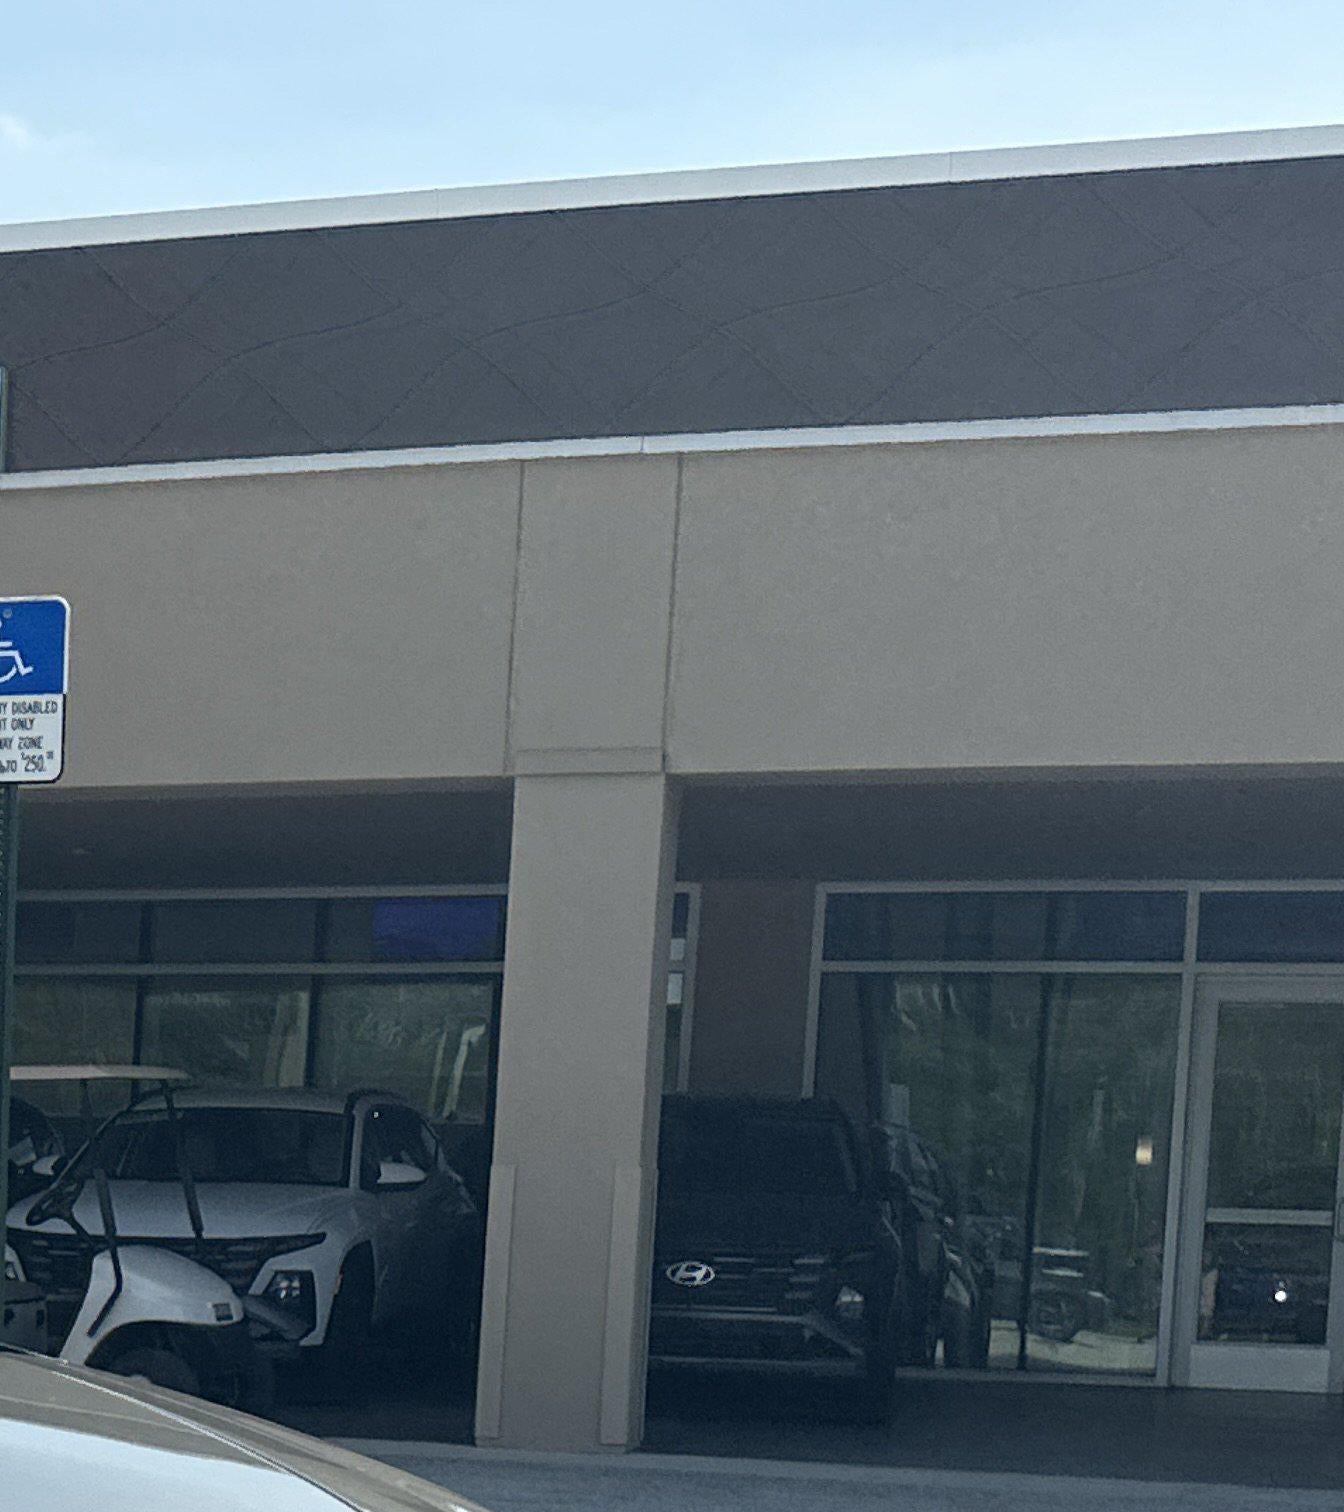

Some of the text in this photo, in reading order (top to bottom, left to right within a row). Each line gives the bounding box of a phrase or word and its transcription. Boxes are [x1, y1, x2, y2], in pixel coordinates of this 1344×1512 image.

[12, 701, 58, 715] DISABLED
[11, 718, 35, 731] ONLY
[18, 736, 43, 749] ZONE
